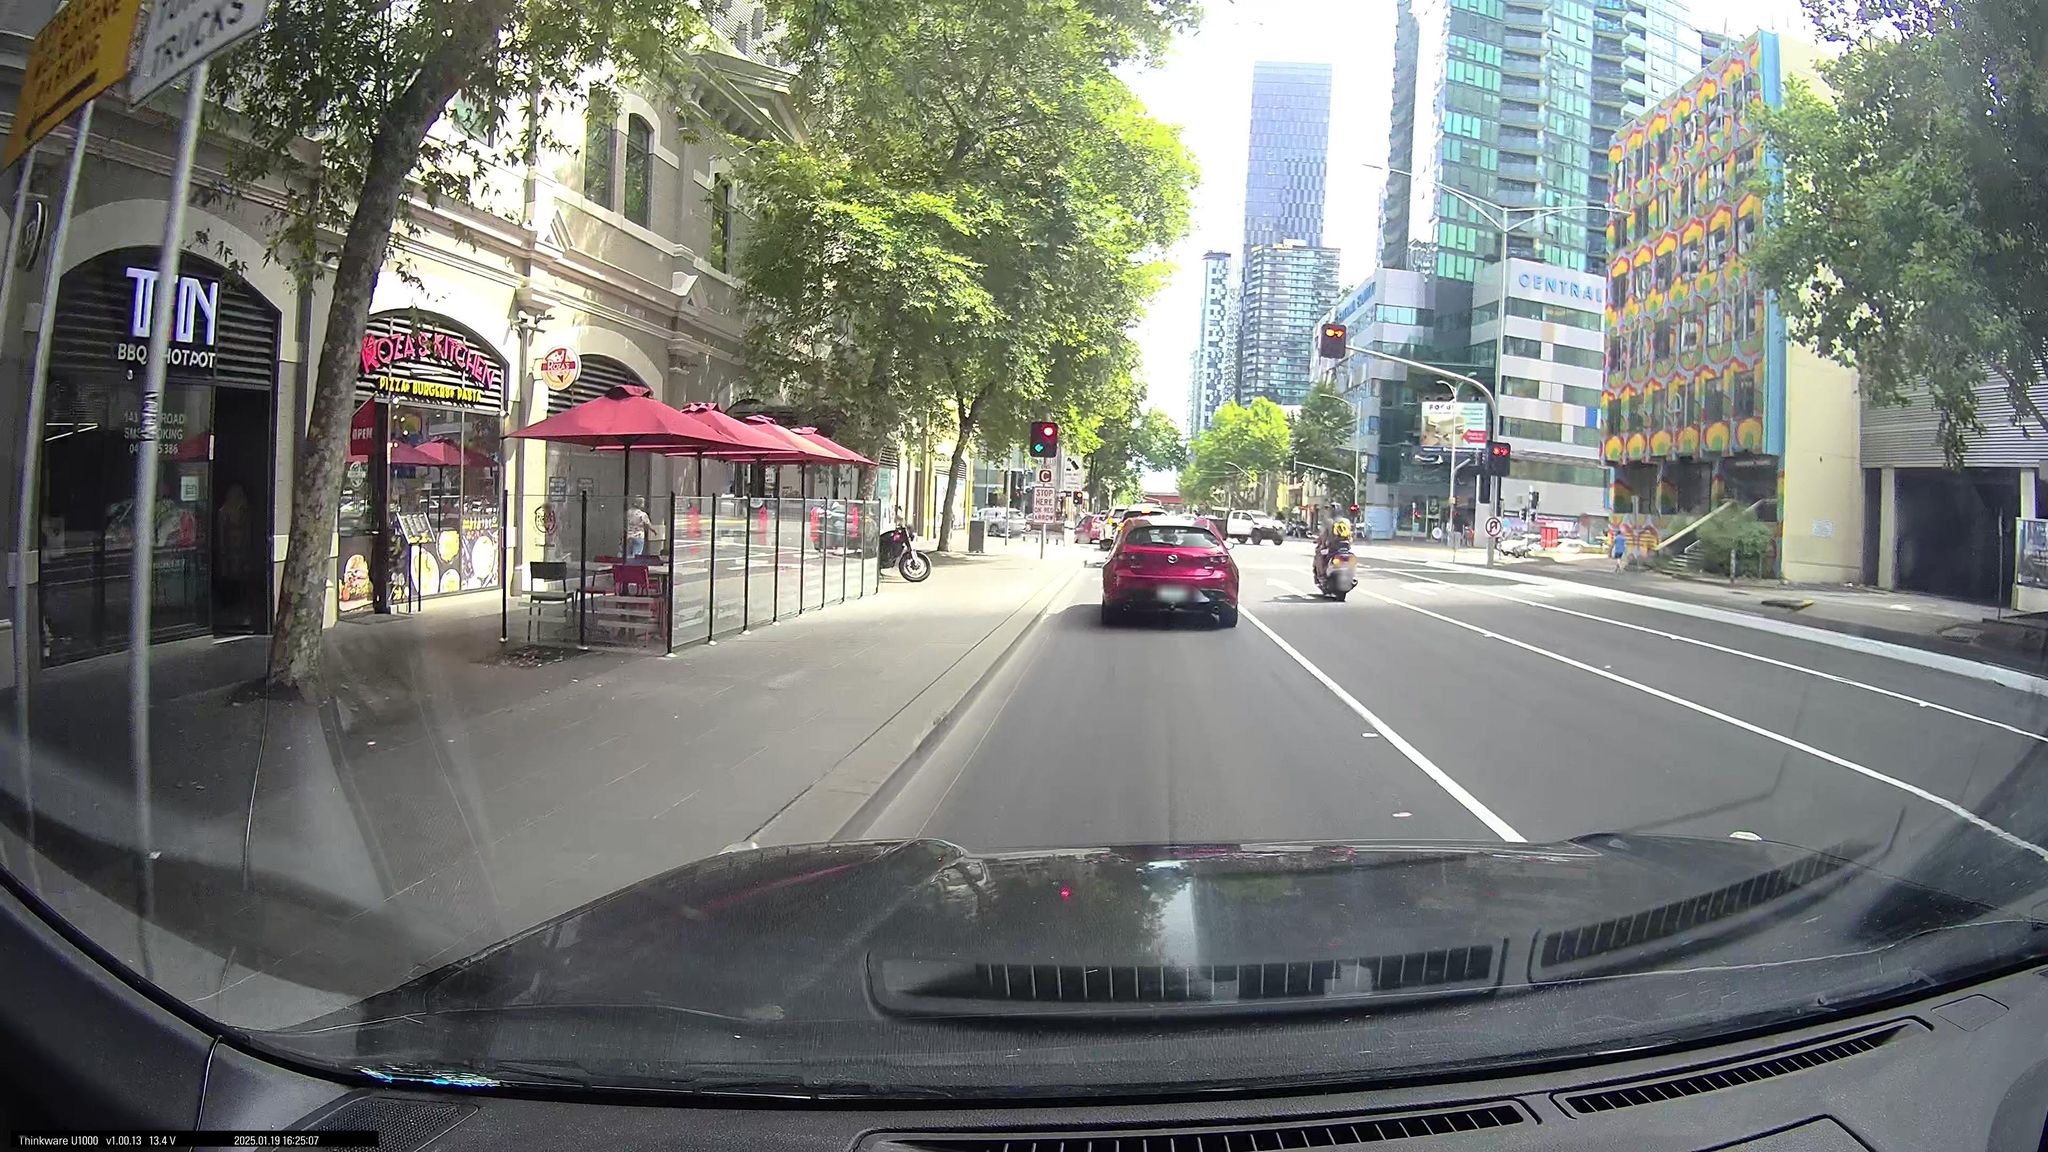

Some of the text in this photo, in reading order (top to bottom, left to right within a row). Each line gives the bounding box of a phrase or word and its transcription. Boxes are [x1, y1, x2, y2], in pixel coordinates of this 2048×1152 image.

[1518, 271, 1603, 304] CENTRAL
[117, 343, 148, 365] BBQ
[432, 332, 496, 390] KITCHEN
[379, 376, 482, 402] PIZZA BURGERS PASTA
[1036, 498, 1053, 506] HERE
